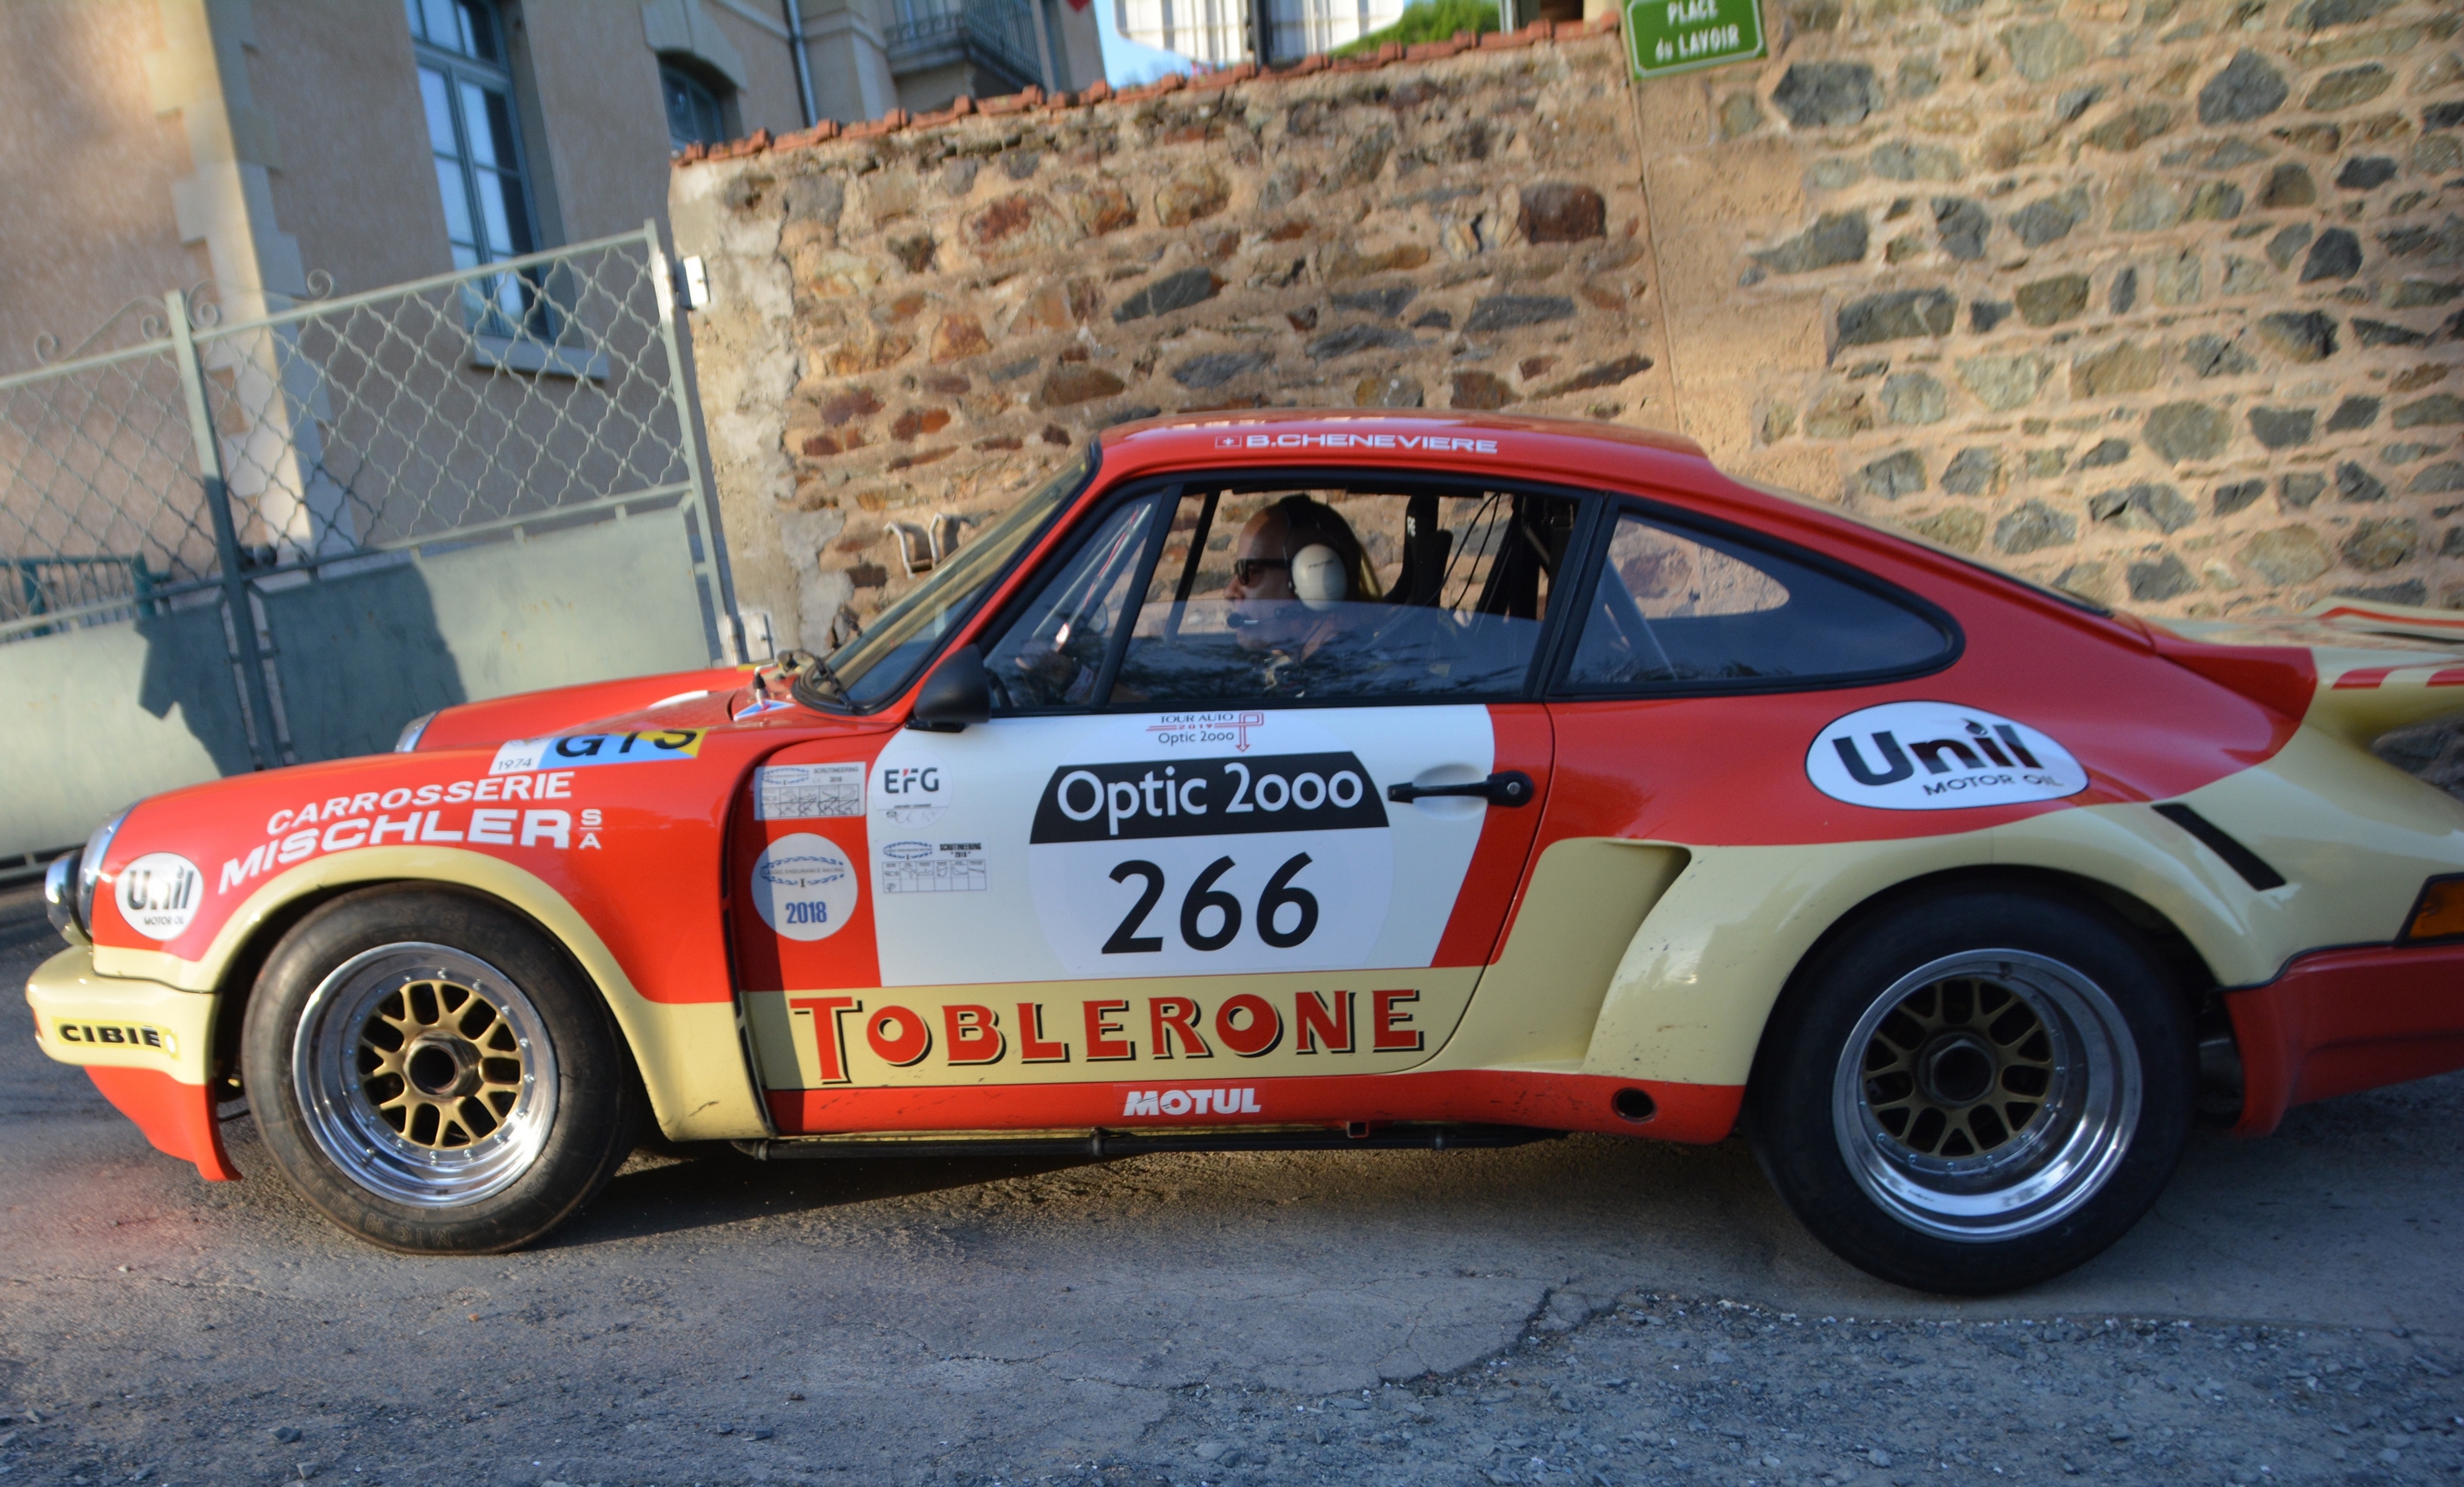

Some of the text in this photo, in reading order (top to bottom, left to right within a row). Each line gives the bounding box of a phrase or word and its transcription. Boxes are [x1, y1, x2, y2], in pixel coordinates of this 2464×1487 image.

[1667, 0, 1719, 27] PLACE
[1678, 23, 1741, 58] LAVOIR
[1246, 433, 1499, 454] B.CHENEVIERE
[1160, 713, 1234, 723] TOUR AUTO
[1158, 732, 1196, 746] Optic
[1832, 718, 2044, 786] Unil
[497, 758, 532, 770] 1974
[884, 767, 940, 794] EFG
[1922, 774, 2065, 796] MOTOR OIL
[267, 770, 575, 835] CARROSSERIE
[1057, 765, 1208, 835] Optic
[218, 809, 572, 895] MISCHLER
[126, 864, 195, 910] Unil
[785, 900, 827, 924] 2018
[1101, 851, 1319, 955] 266
[144, 915, 172, 926] MOTOR
[789, 987, 1426, 1084] TOBLERONE
[1122, 1087, 1262, 1117] MOTUL
